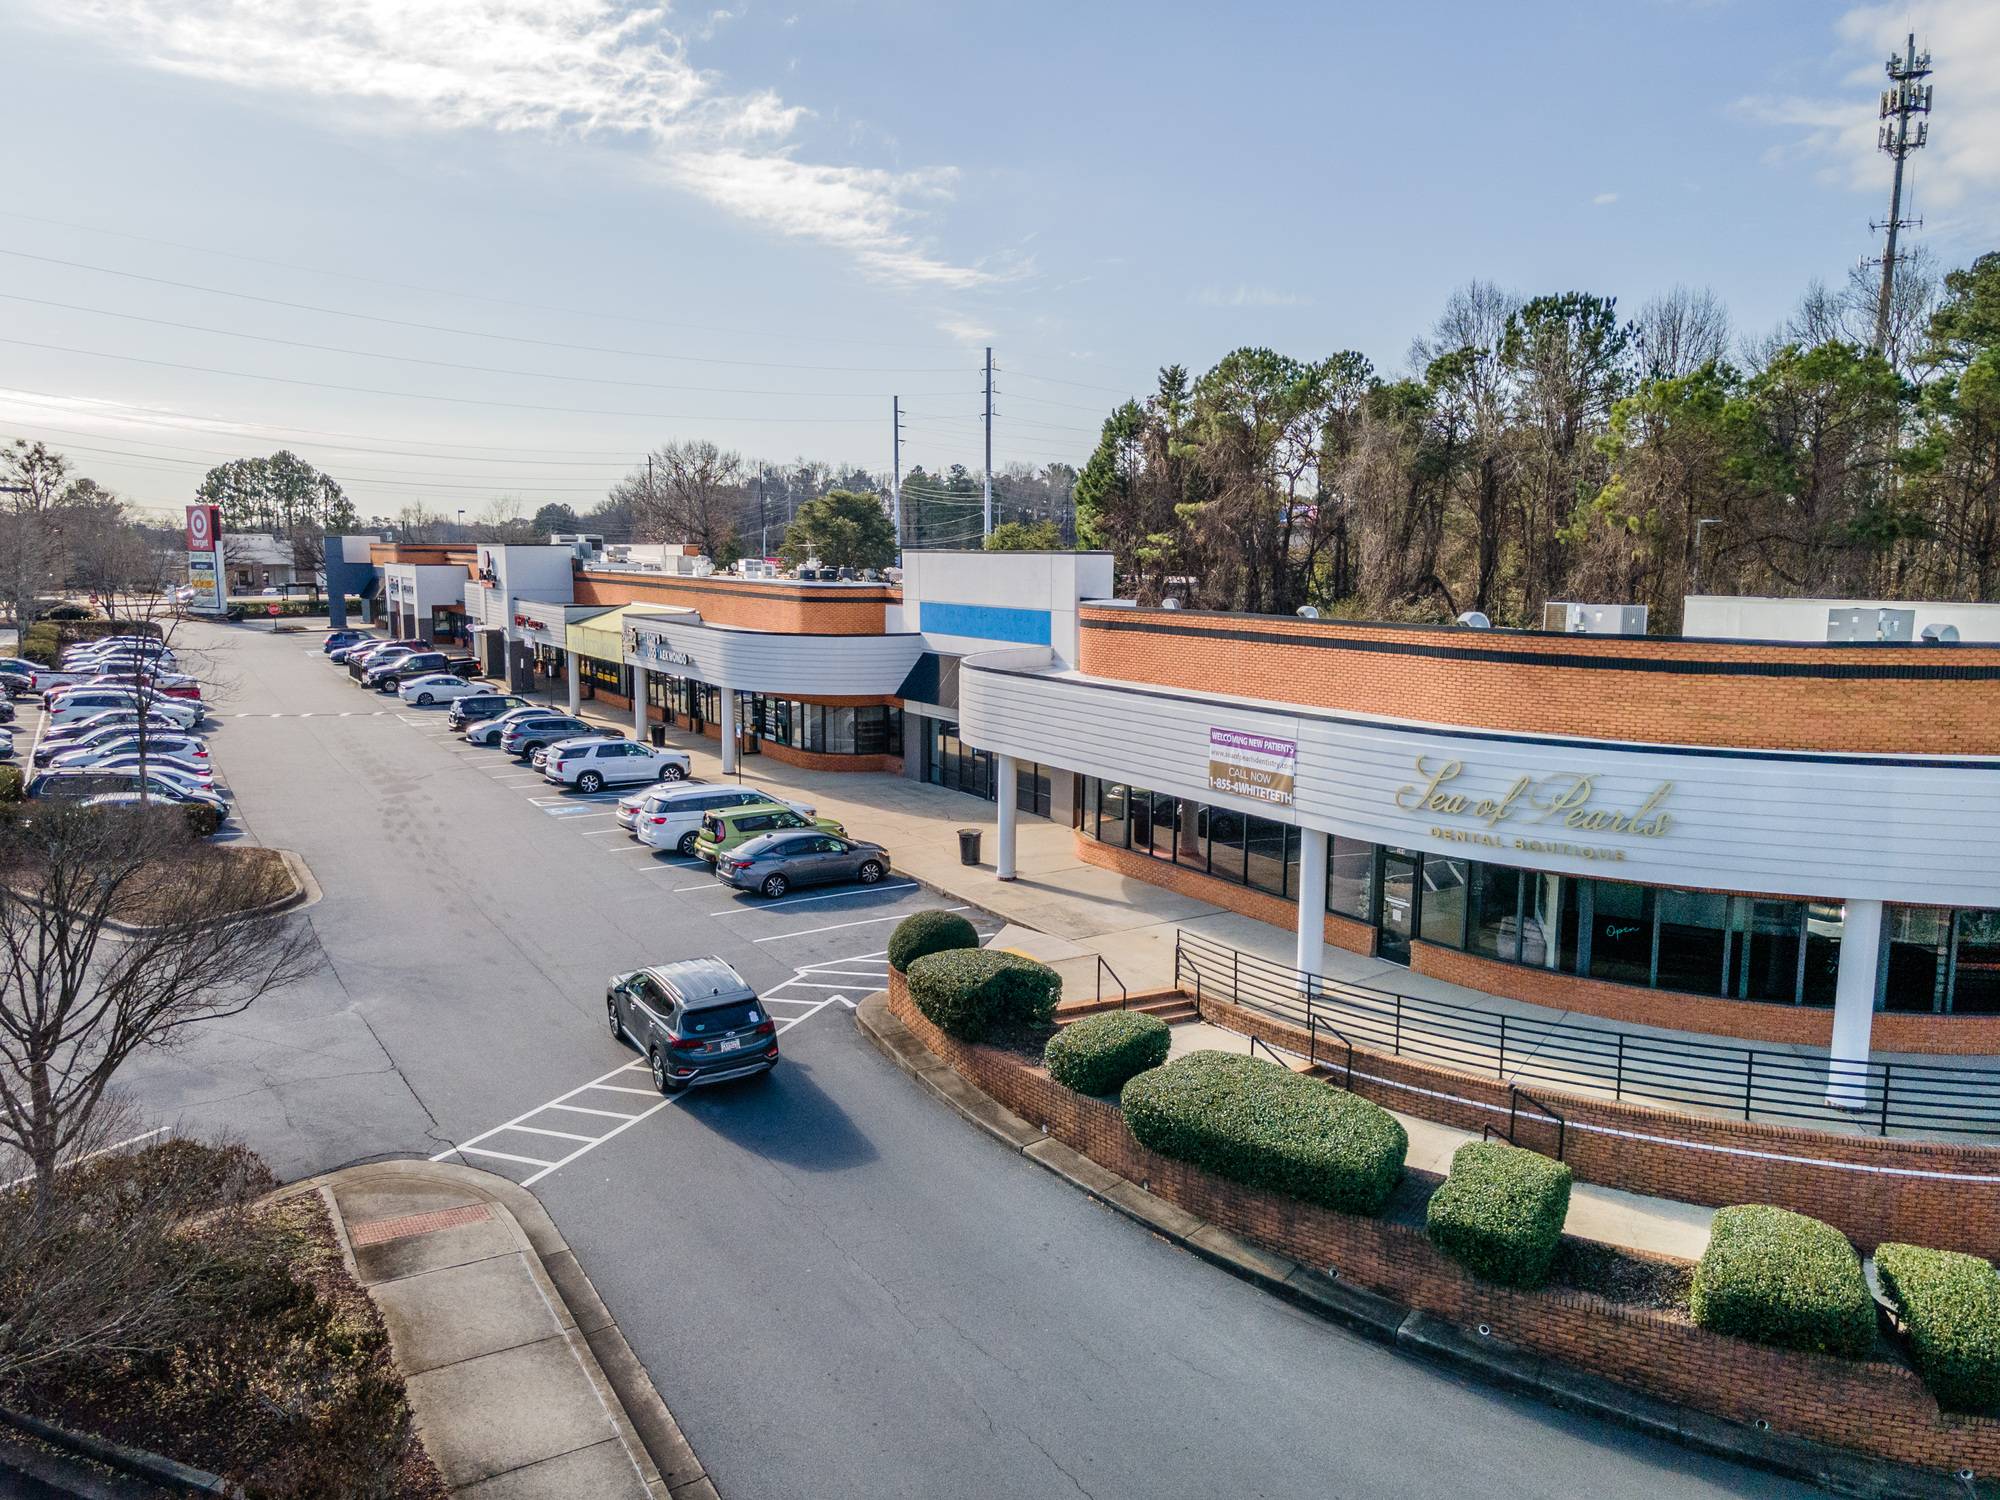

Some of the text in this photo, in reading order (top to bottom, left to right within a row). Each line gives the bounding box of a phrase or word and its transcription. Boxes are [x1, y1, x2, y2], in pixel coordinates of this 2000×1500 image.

[1212, 731, 1294, 754] WELCOMING NEW PATIENTS
[1228, 767, 1272, 785] CALL NOW
[1209, 776, 1293, 804] 1-855-4WHITETEETH
[1395, 753, 1675, 838] Sea of Pearls
[1430, 826, 1628, 862] DENTAL BOUTIQUE
[1606, 924, 1640, 941] Open
